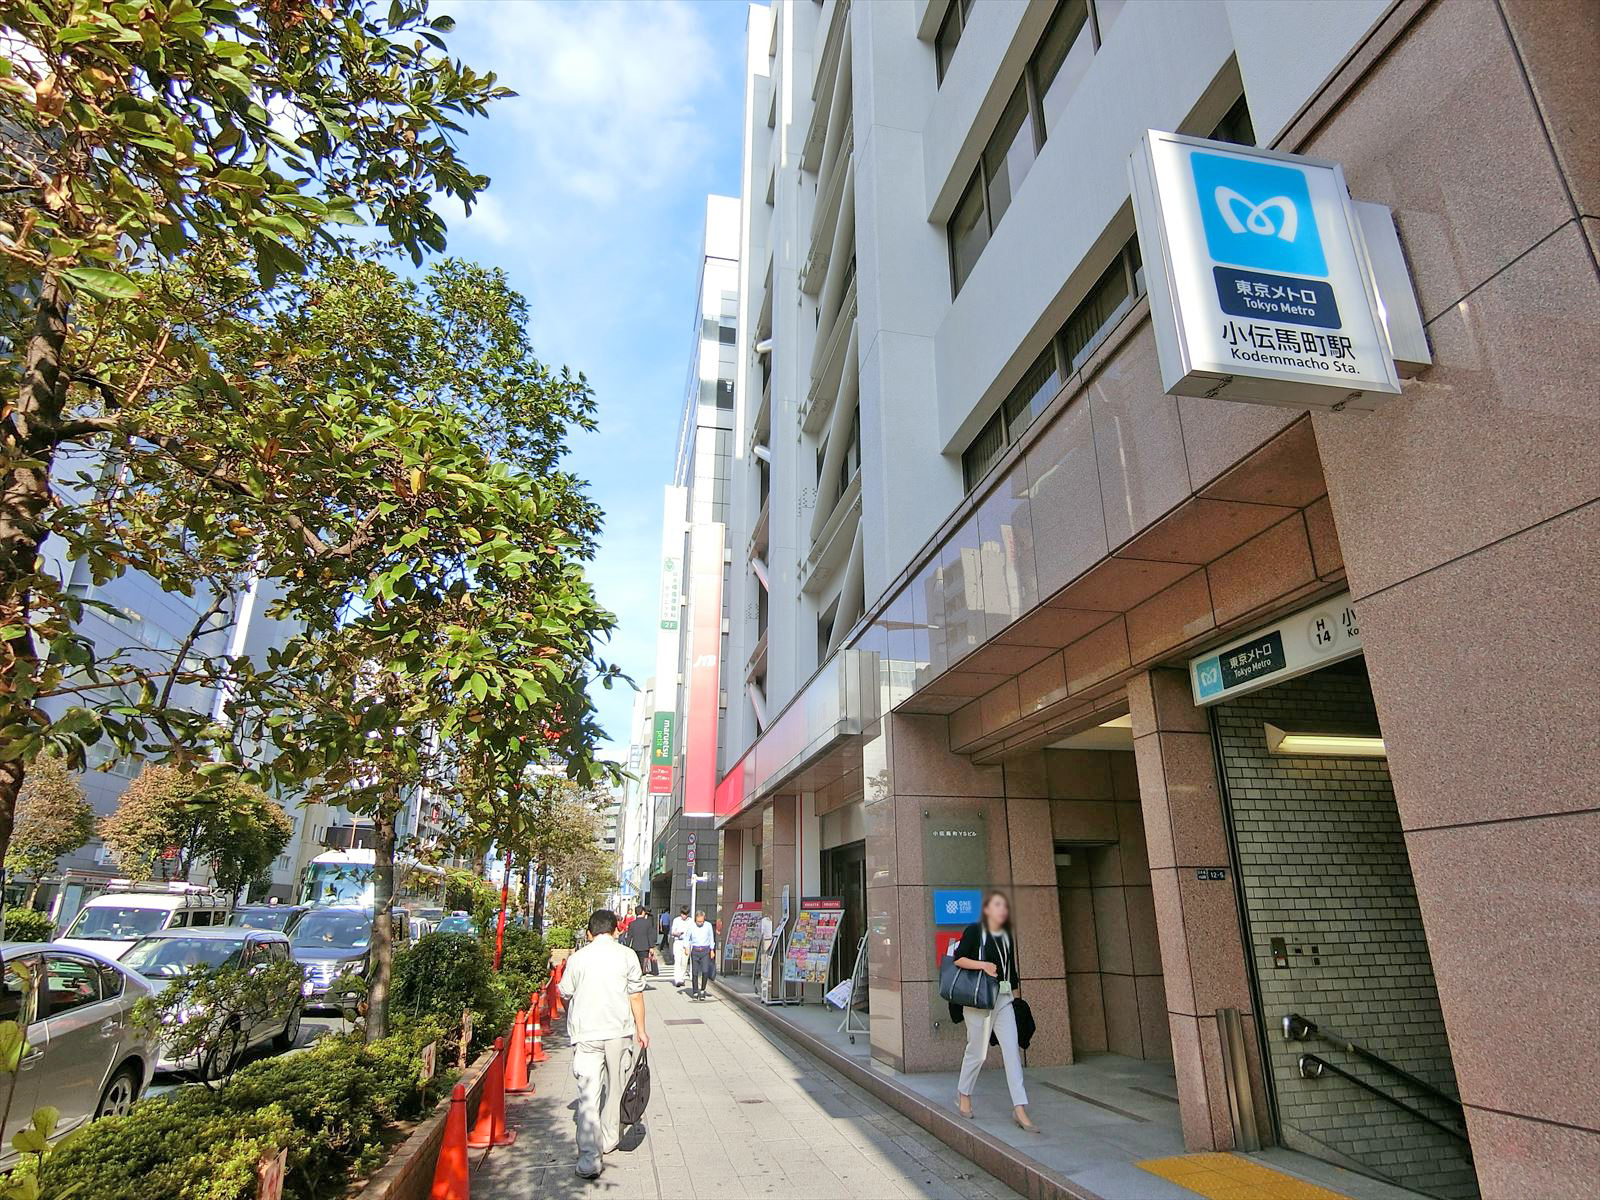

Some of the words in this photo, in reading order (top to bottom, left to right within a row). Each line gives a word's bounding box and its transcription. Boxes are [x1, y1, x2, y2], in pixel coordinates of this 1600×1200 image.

[1235, 279, 1317, 305] 東京メトロ
[1243, 297, 1279, 313] Tokyo
[1280, 303, 1316, 317] Metro
[1222, 320, 1356, 360] 小伝馬町駅
[1231, 347, 1330, 371] Kodemmacho
[1335, 360, 1361, 375] Sta.
[1316, 618, 1325, 631] H
[1316, 630, 1331, 645] 14
[1229, 643, 1273, 669] 東京メトロ
[1234, 664, 1252, 680] Tokyo
[1252, 658, 1272, 673] Metro
[662, 719, 670, 758] maruetsu
